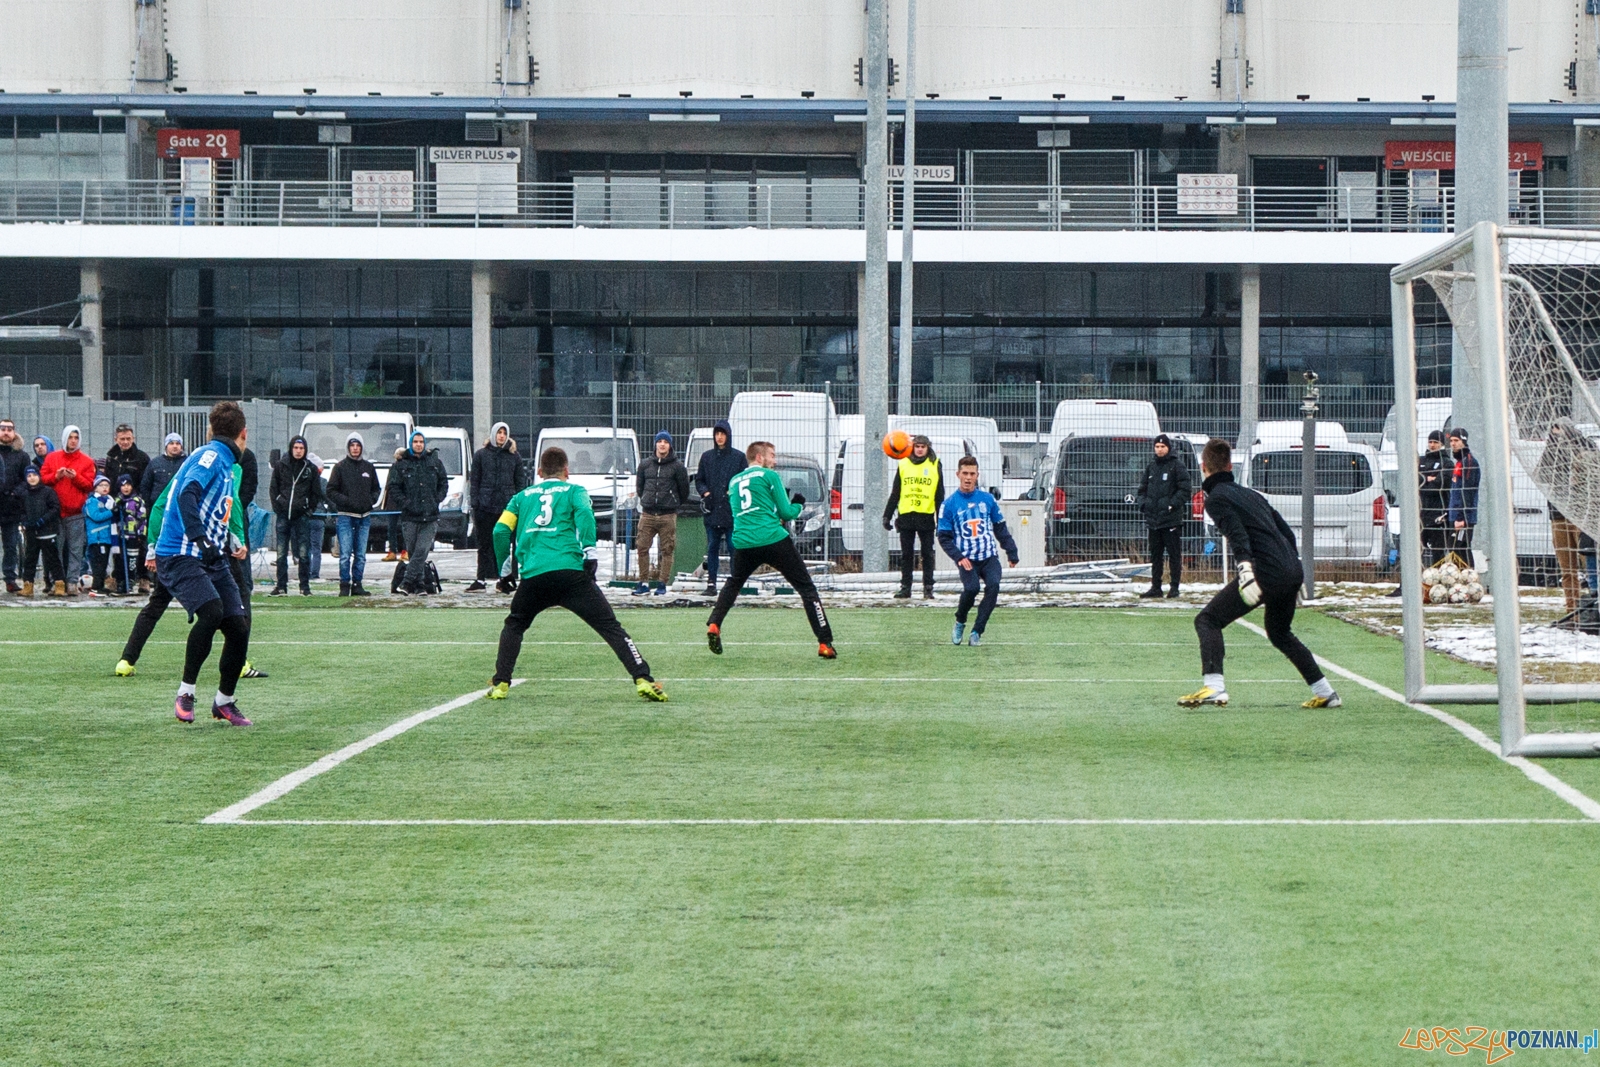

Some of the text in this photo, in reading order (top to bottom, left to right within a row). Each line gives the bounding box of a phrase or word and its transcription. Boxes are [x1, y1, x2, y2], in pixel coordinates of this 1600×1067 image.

[169, 134, 227, 147] Gate 20
[433, 150, 504, 160] SILVER PLUS
[1401, 149, 1452, 162] WEJŚCIE
[1513, 152, 1528, 163] 21
[887, 168, 951, 179] ILVR PLUS
[903, 476, 932, 486] STEWARD
[738, 479, 752, 510] 5
[534, 494, 553, 526] 3
[962, 519, 985, 538] STS
